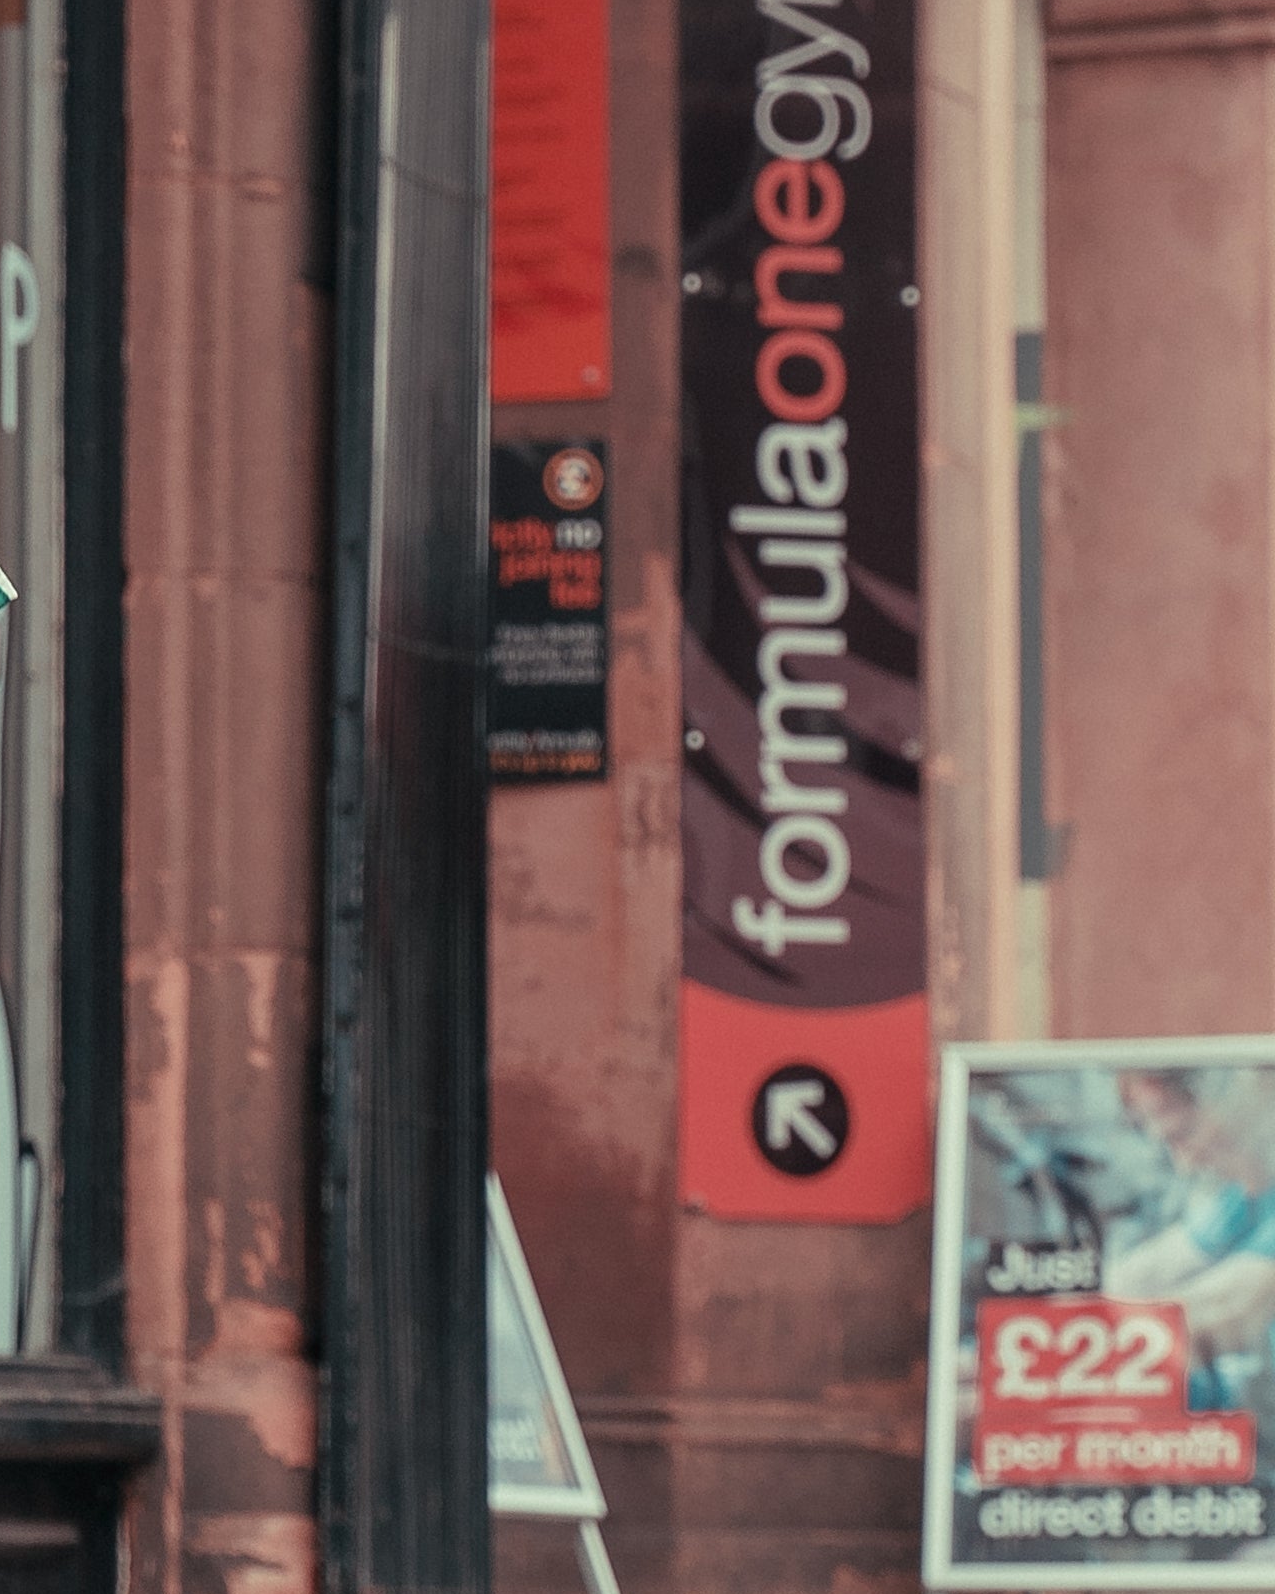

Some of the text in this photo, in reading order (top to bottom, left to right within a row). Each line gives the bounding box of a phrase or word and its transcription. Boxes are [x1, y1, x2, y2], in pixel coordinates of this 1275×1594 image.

[986, 1242, 1098, 1293] Just
[994, 1315, 1173, 1399] £22
[983, 1419, 1241, 1485] per month
[978, 1487, 1266, 1539] direct debit
